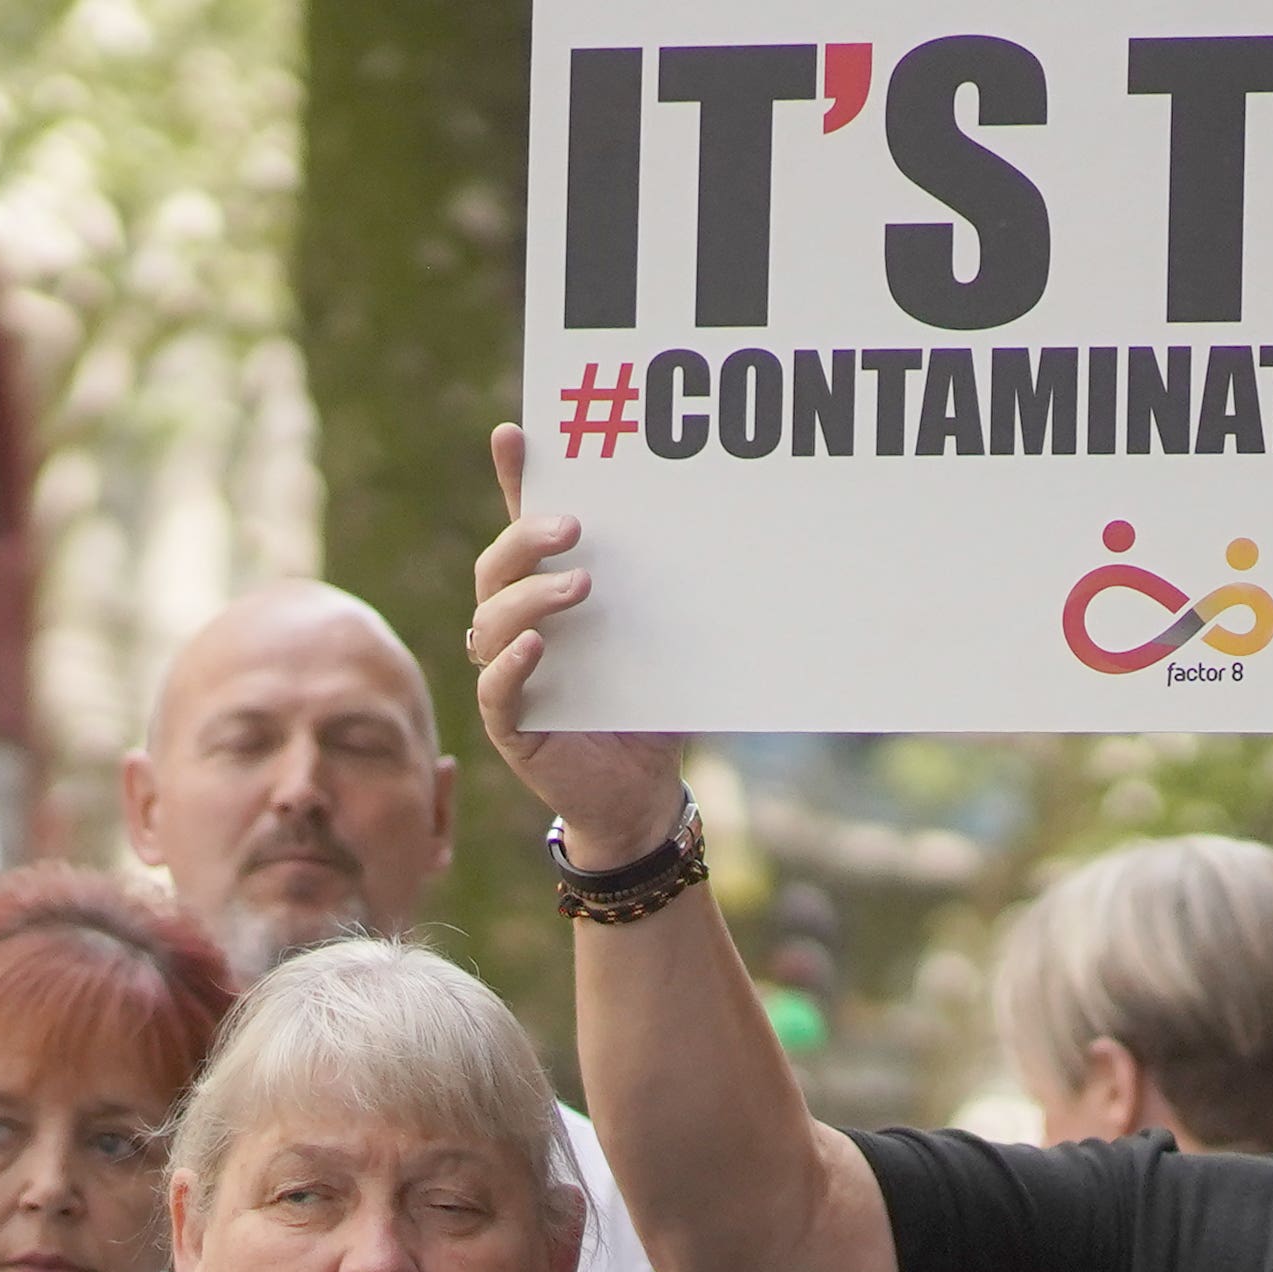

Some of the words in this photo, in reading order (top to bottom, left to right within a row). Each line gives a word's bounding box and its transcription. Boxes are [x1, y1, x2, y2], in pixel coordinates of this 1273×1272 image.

[564, 35, 1051, 331] IT'S
[1167, 662, 1226, 687] factor
[1231, 662, 1244, 682] 8
